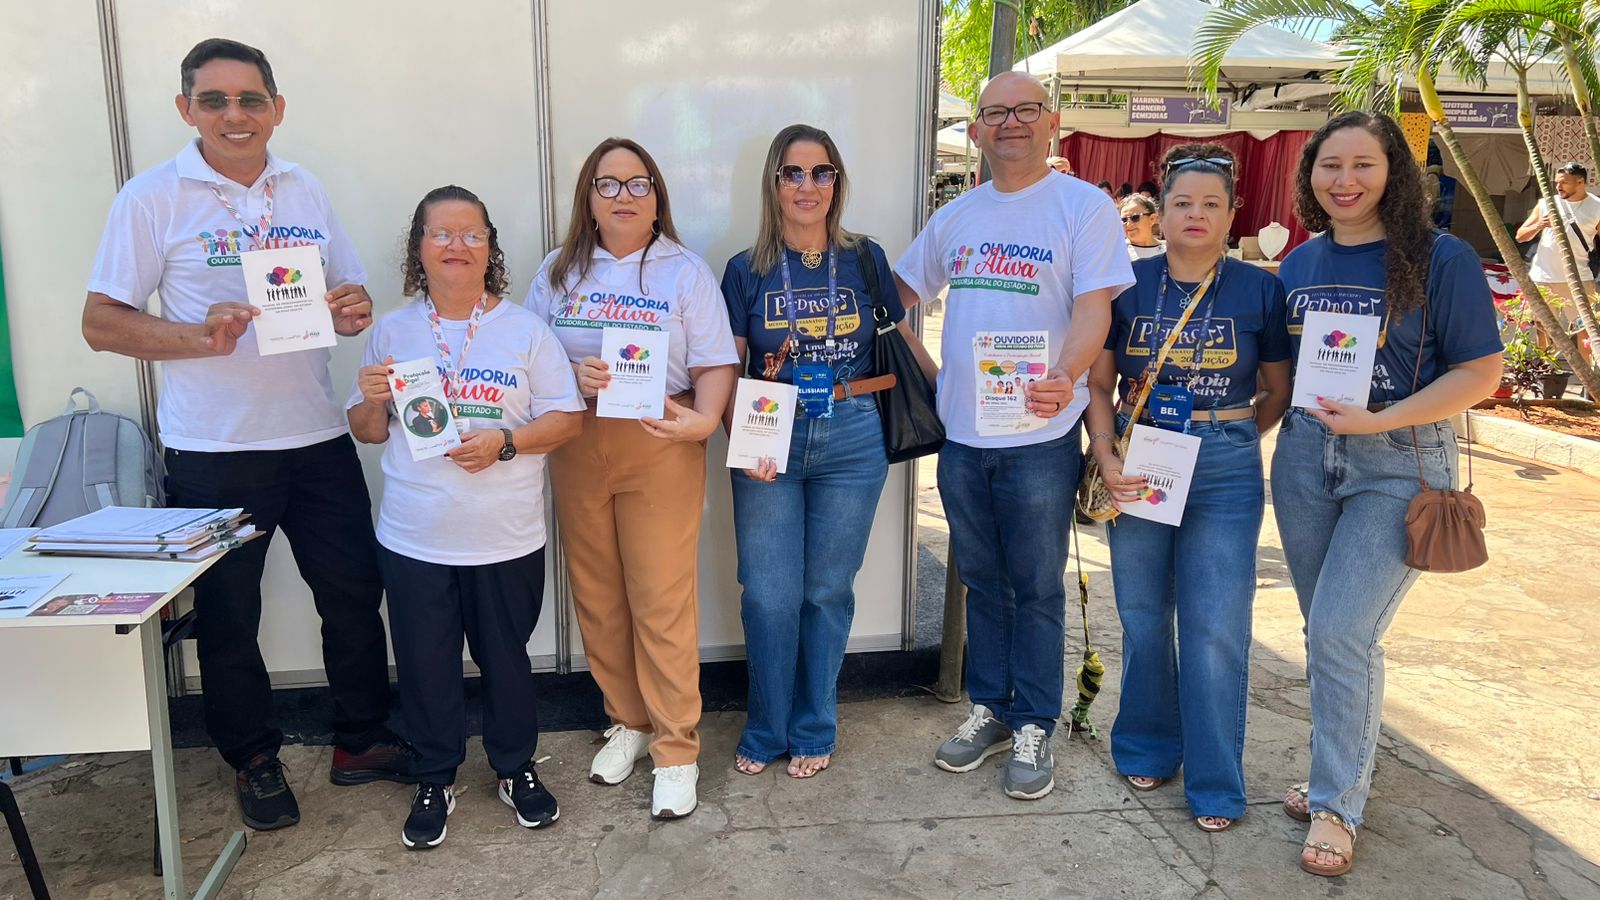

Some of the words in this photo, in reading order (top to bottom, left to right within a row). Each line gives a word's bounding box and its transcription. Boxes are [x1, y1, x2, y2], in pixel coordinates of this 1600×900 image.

[1132, 104, 1167, 112] CARNEIRO
[1132, 112, 1168, 120] SEMIJOIAS
[979, 242, 1054, 264] OUVIDORIA
[974, 246, 1039, 279] Ativa
[974, 278, 992, 287] GERAL
[1003, 281, 1027, 291] ESTADO
[1031, 285, 1038, 293] PI
[590, 292, 670, 313] OUVIDORIA
[774, 296, 829, 316] PDRO
[1292, 294, 1353, 319] PEDRO
[588, 297, 660, 323] Ativa
[622, 323, 649, 331] ESTADO
[836, 322, 855, 332] IÇÃO
[994, 335, 1046, 344] OUVIDORIA
[1203, 355, 1230, 366] DIÇÃO
[463, 405, 492, 415] ESTADO
[1160, 406, 1179, 416] BEL
